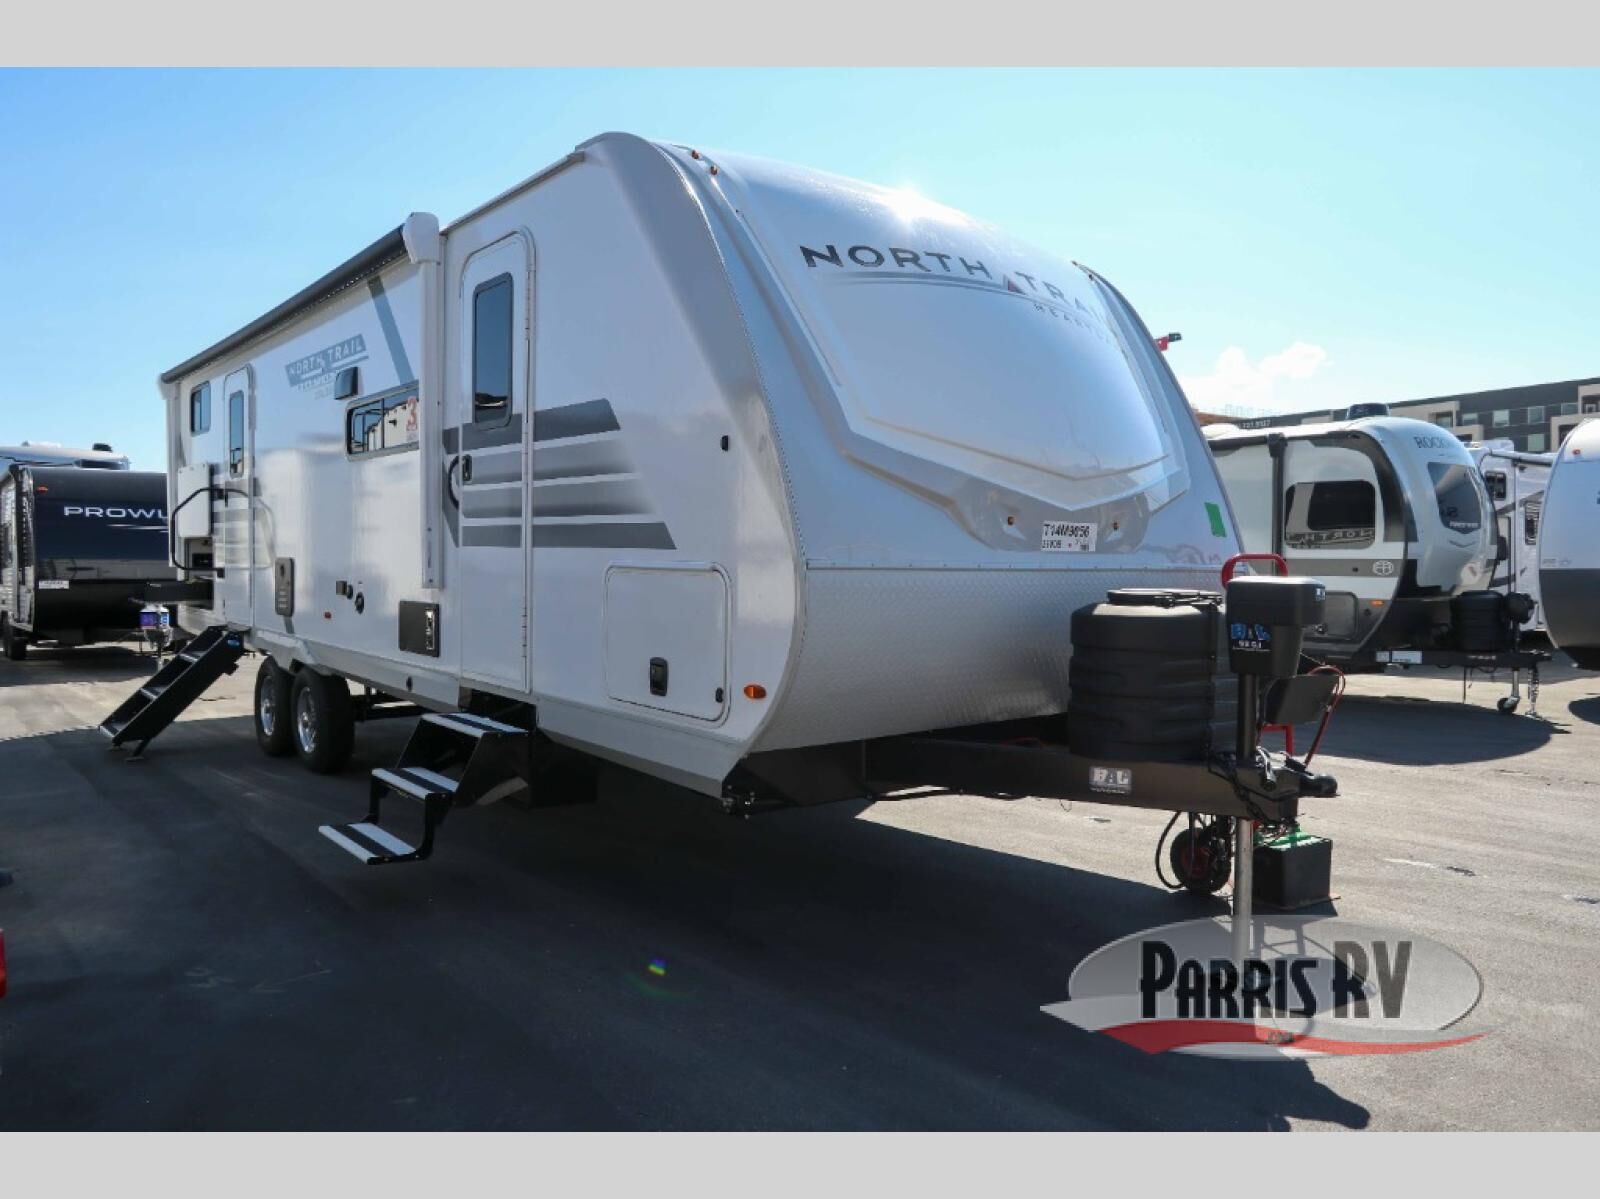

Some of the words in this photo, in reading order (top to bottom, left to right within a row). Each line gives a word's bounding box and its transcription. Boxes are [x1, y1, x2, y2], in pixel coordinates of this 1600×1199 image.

[800, 244, 992, 280] NORTH
[288, 354, 326, 376] NORTH
[327, 336, 364, 362] TRAIL
